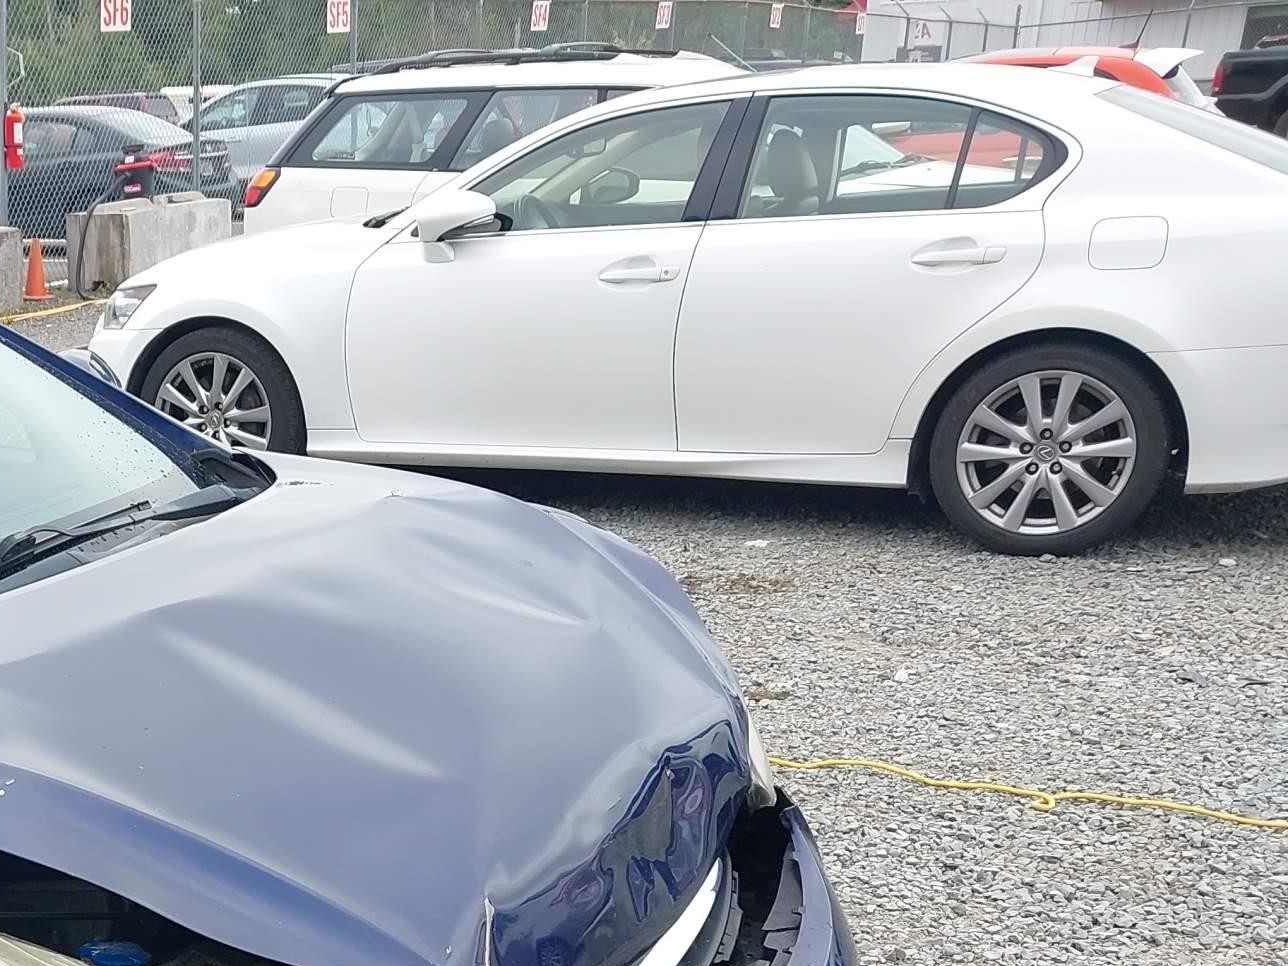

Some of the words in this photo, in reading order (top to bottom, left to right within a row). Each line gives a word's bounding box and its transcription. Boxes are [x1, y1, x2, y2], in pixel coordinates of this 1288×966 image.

[103, 0, 129, 26] SF6
[329, 1, 349, 28] SF5
[533, 4, 548, 27] SF4
